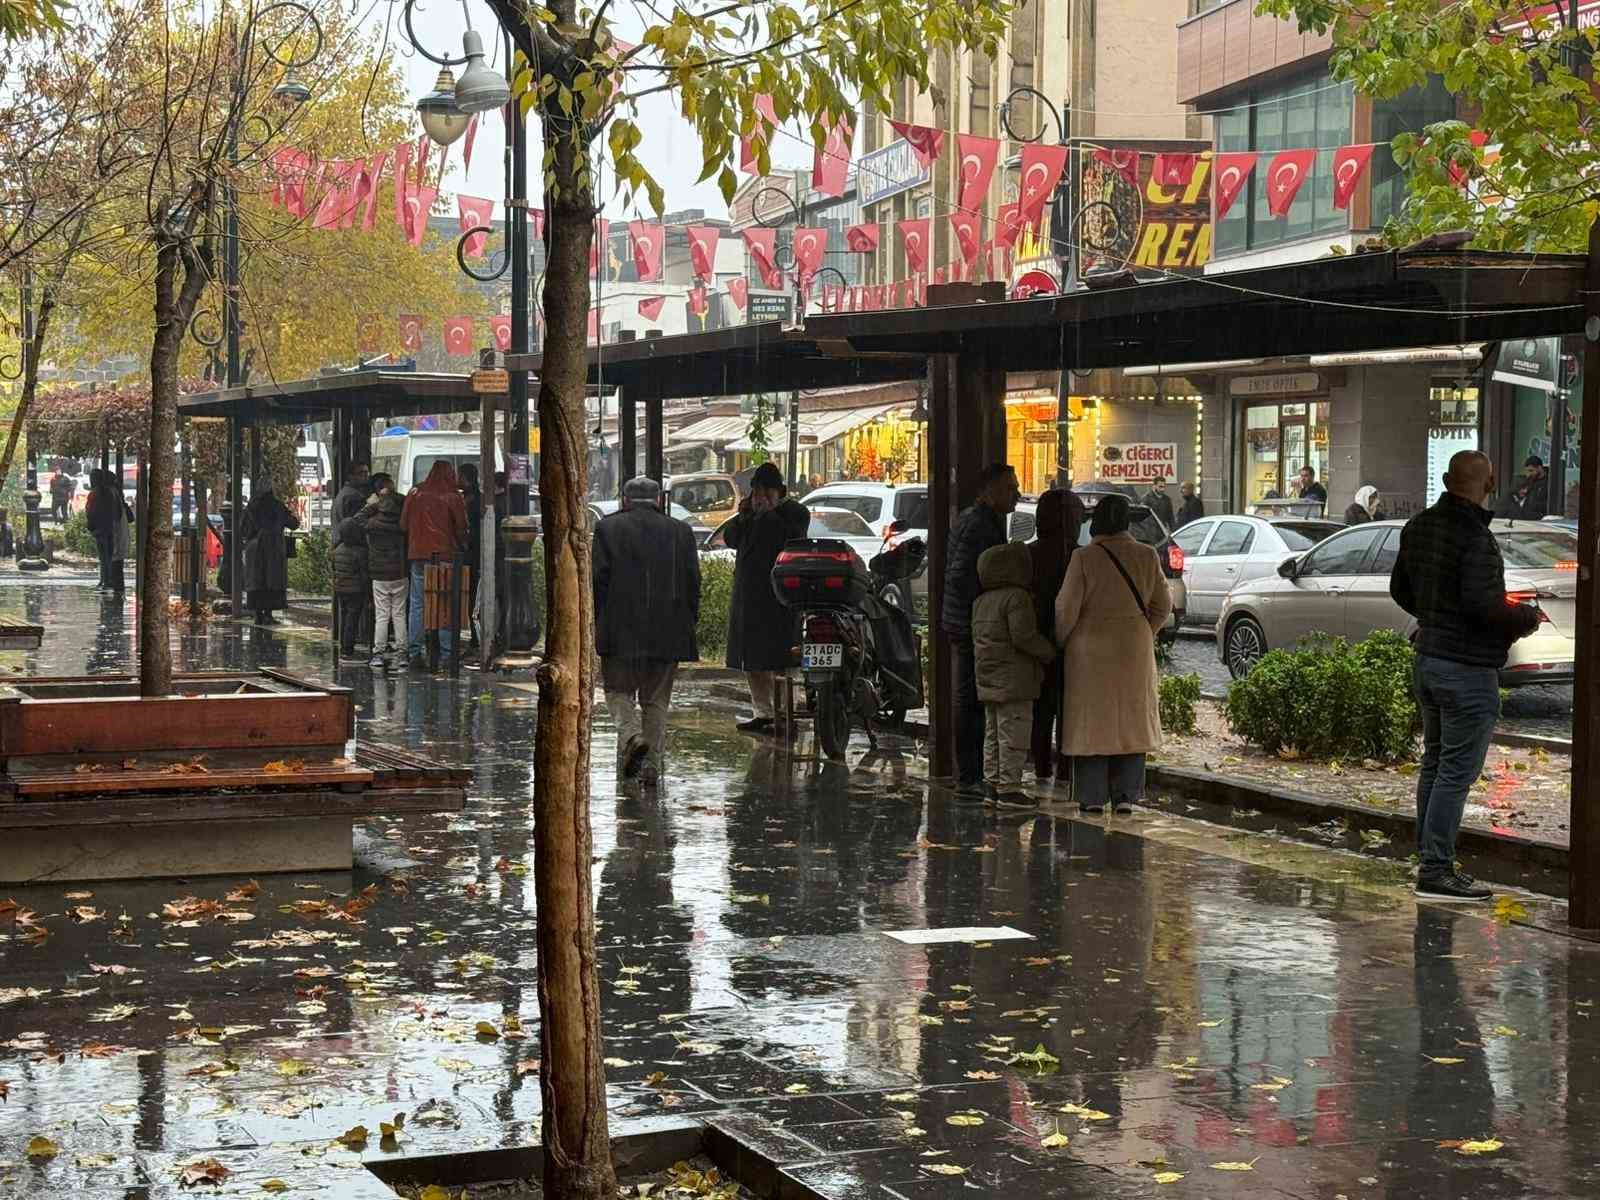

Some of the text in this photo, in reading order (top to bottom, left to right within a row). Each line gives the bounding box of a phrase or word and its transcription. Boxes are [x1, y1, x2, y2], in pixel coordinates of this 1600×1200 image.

[1126, 445, 1174, 460] CİĞERCİ
[1102, 462, 1174, 477] REMZİ USTA
[804, 645, 817, 656] 21
[811, 656, 833, 666] 365
